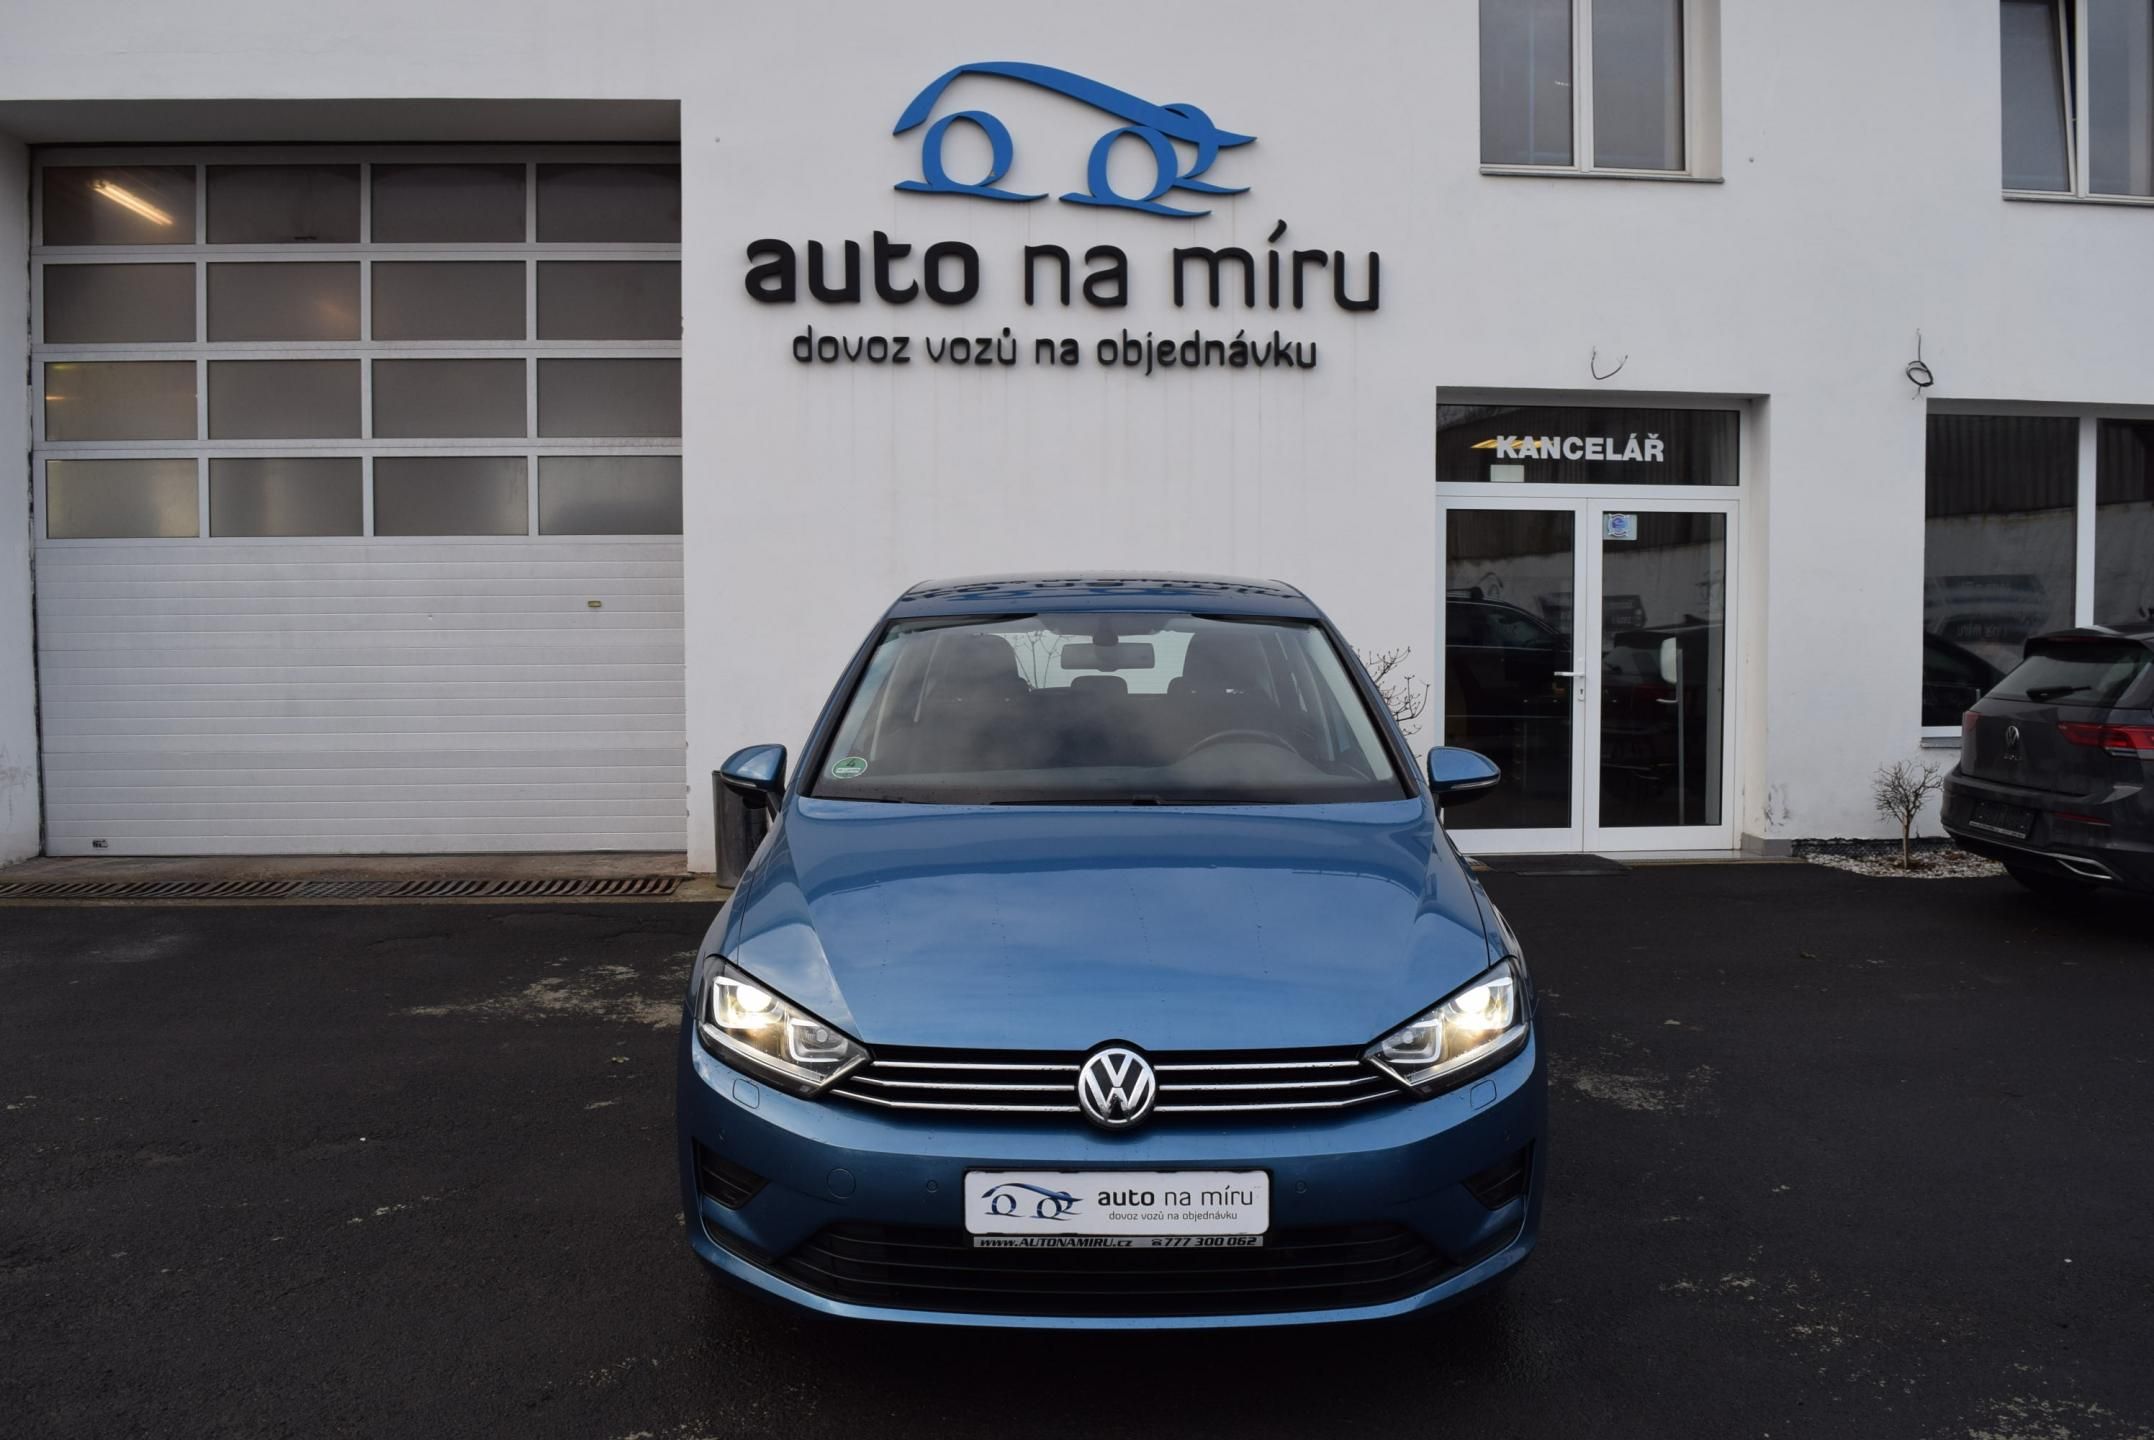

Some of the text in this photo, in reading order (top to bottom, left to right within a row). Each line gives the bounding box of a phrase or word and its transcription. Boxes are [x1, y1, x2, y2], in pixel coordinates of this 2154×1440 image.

[745, 219, 1380, 312] auto na míru
[792, 325, 1317, 376] dovoz vozů na objednávku
[1496, 432, 1665, 463] KANCELÁŘ
[1097, 1185, 1253, 1207] auto na míru
[1108, 1210, 1238, 1222] dovoz vozů na objednávku
[1165, 1237, 1192, 1247] 777
[1194, 1237, 1224, 1247] 300
[1227, 1236, 1258, 1246] 062
